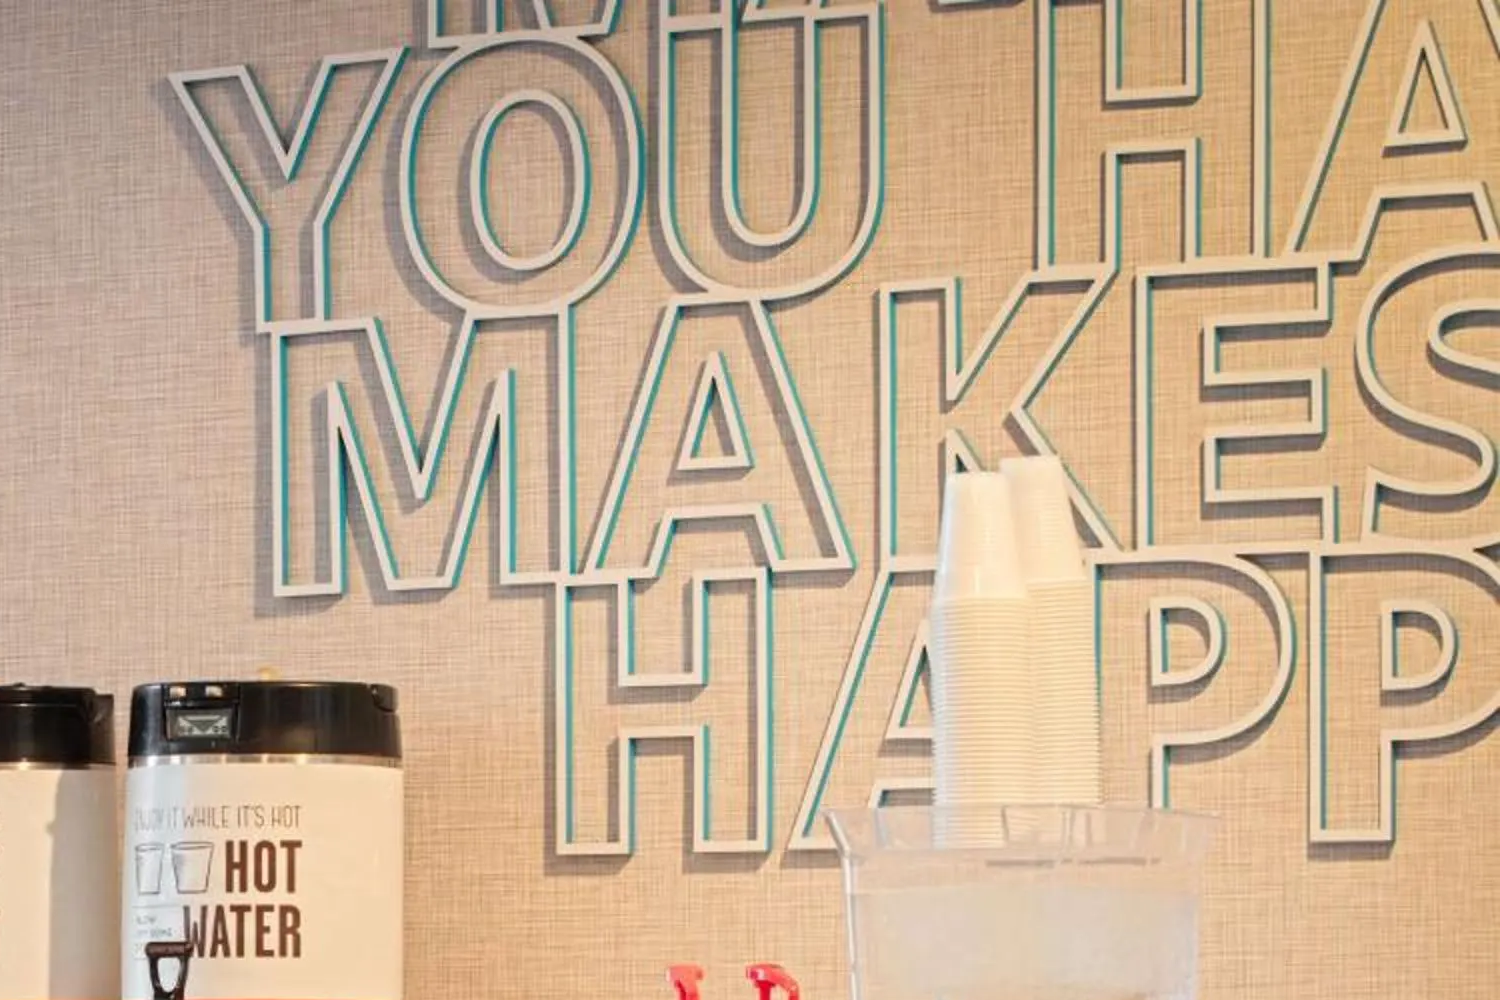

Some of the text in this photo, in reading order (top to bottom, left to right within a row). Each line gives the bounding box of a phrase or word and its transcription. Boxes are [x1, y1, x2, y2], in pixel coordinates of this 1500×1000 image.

[168, 4, 886, 332] YOU
[272, 242, 1500, 599] MAKES
[182, 805, 230, 830] WHILE
[237, 805, 265, 829] IT'S
[271, 805, 302, 829] HOT
[225, 840, 303, 894] HOT
[182, 904, 303, 959] WATER
